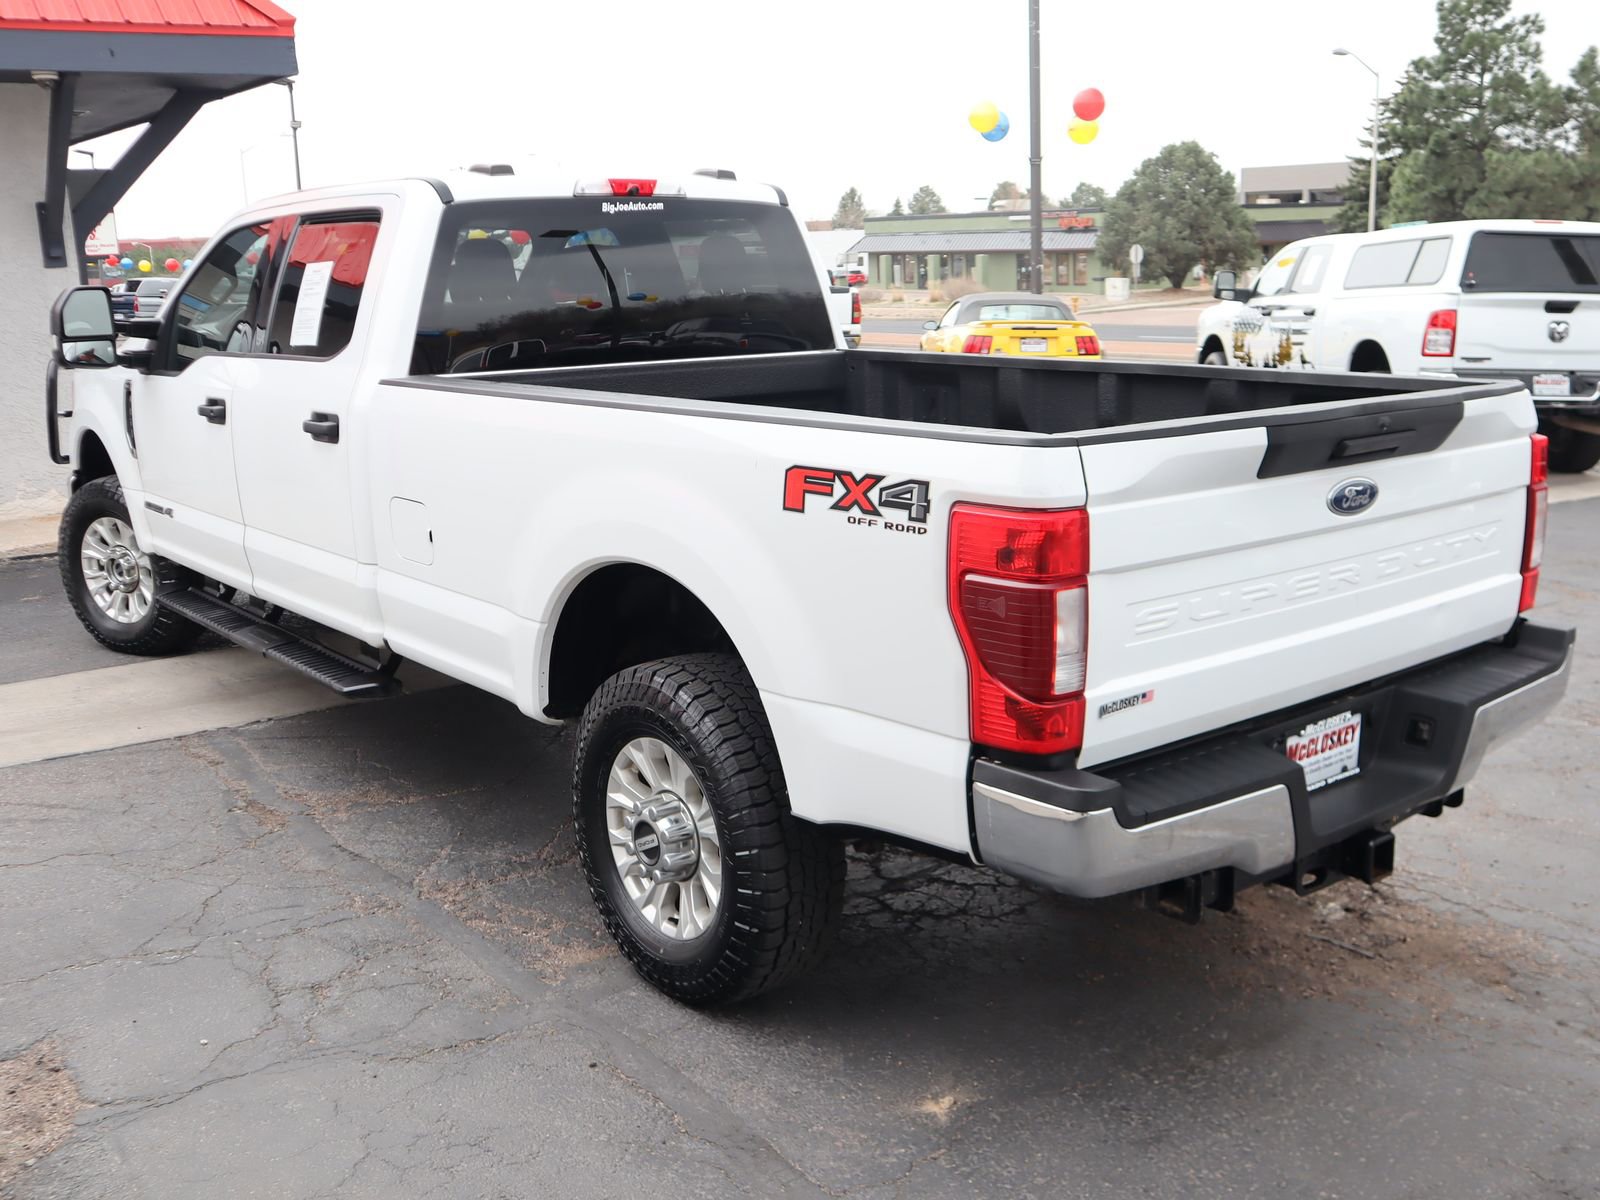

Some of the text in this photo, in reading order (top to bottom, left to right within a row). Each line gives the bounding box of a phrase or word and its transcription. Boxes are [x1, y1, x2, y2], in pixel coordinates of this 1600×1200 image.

[601, 201, 664, 214] BigJoeAuto.com
[783, 464, 931, 524] FX4
[1342, 485, 1371, 509] Ford
[847, 516, 928, 535] OFF ROAD
[1134, 527, 1497, 636] SUPER DUTY
[1287, 722, 1360, 762] McCLOSKEY
